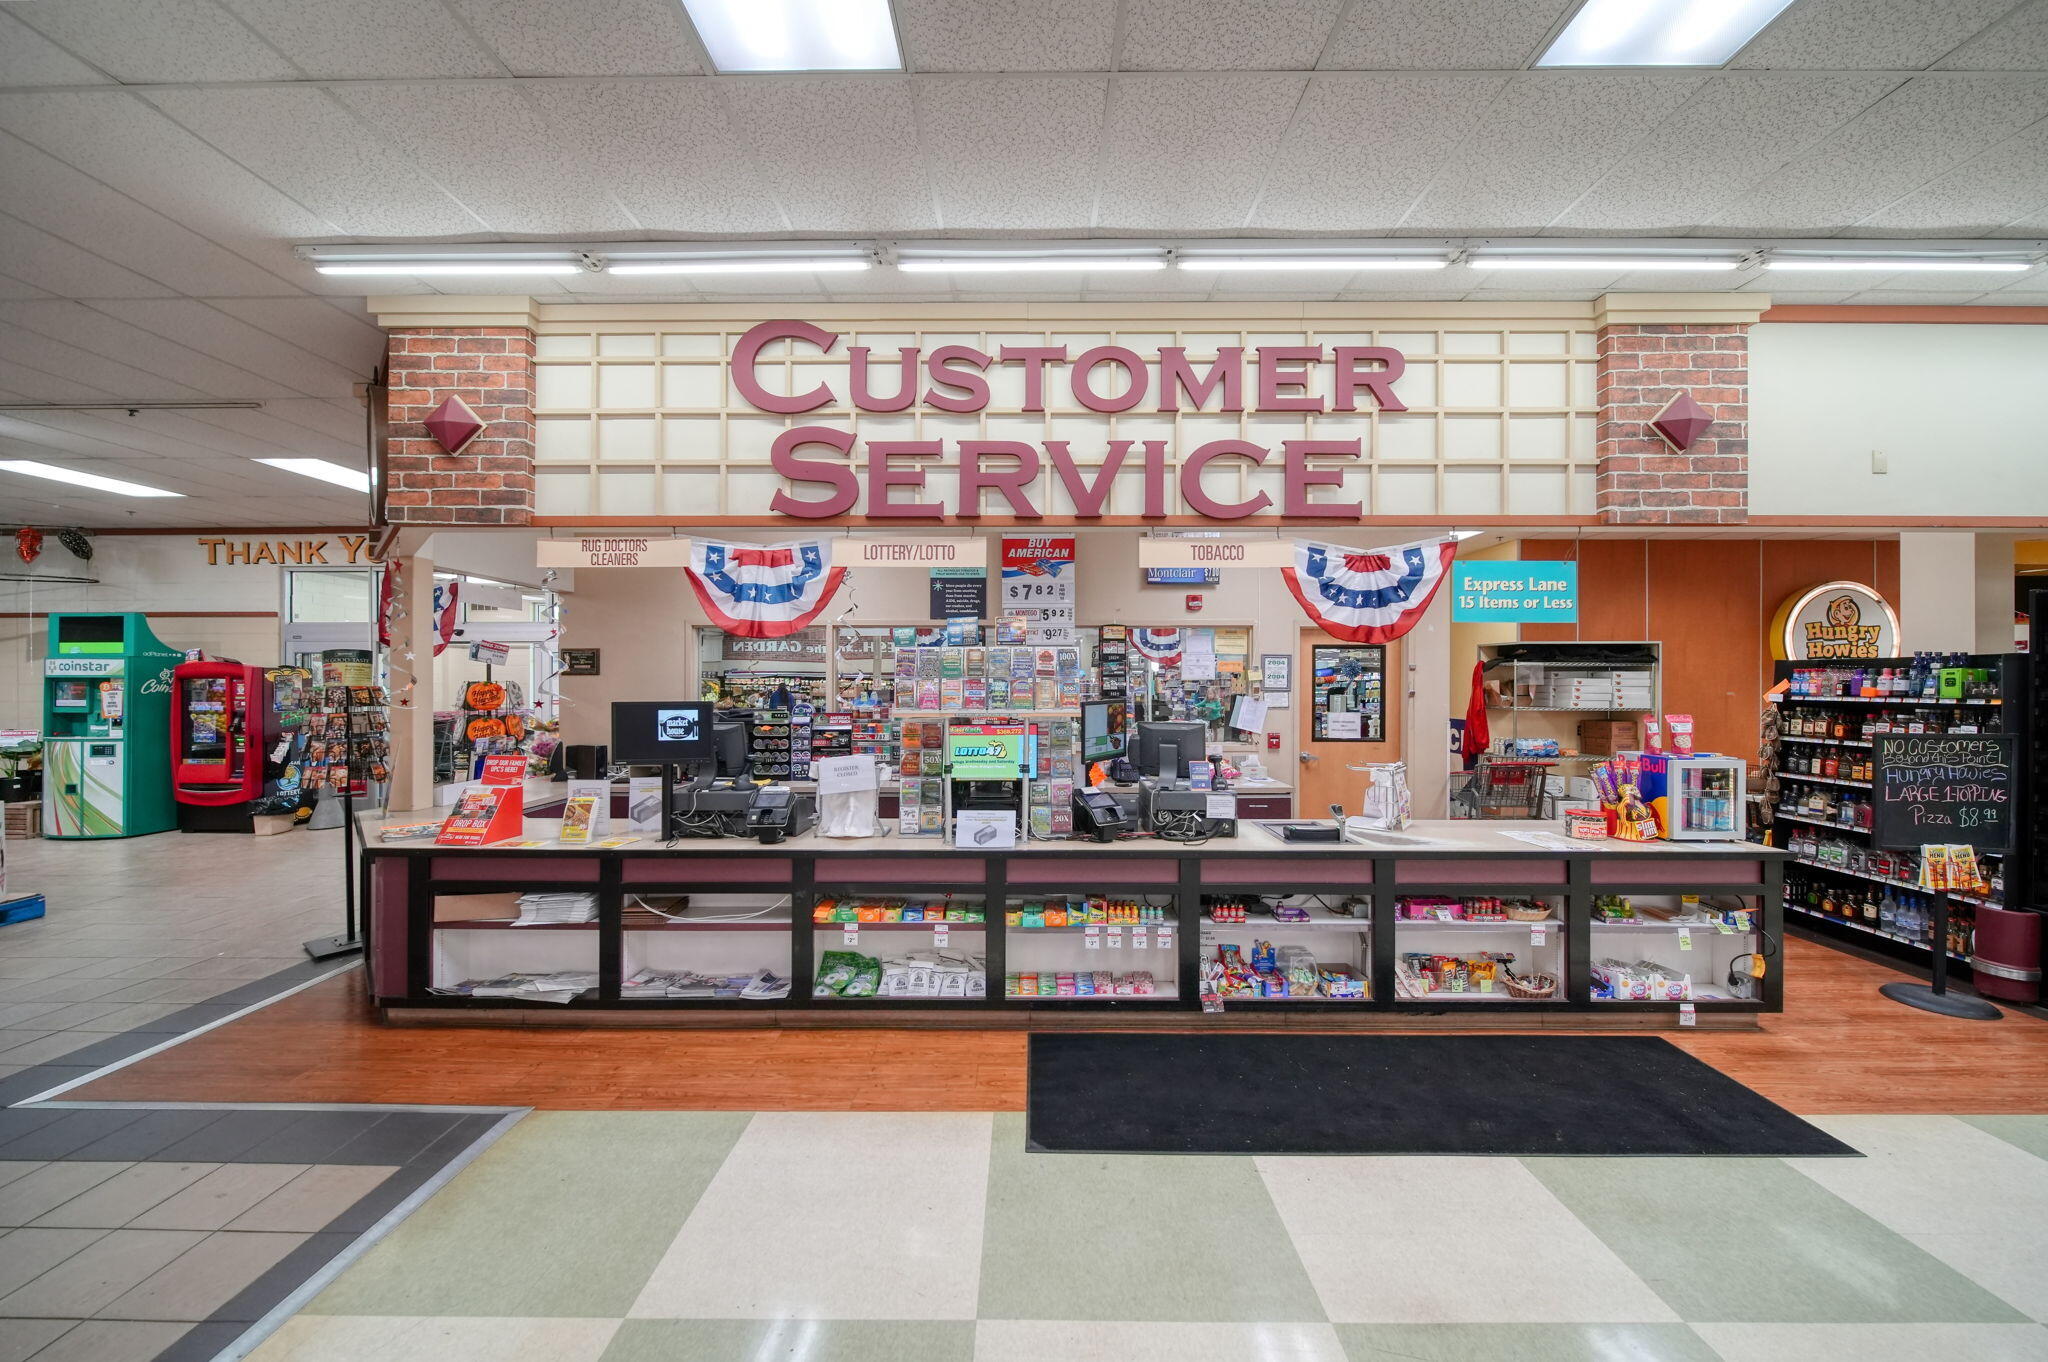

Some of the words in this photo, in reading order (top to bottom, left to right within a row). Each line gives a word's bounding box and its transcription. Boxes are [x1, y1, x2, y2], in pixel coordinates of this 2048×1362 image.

[730, 319, 1408, 414] CUSTOMER
[769, 425, 1363, 520] SERVICE
[198, 537, 328, 565] THANK
[581, 538, 601, 552] RUG
[604, 538, 648, 552] DOCTORS
[1028, 538, 1053, 548] BUY
[590, 552, 638, 566] CLEANERS
[863, 544, 955, 560] LOTTERY/LOTTO
[1007, 548, 1069, 558] AMERICAN
[1190, 544, 1245, 560] TOBACCO
[1148, 568, 1197, 578] Montclair
[1464, 576, 1524, 595] Express
[1528, 576, 1568, 592] Lane
[1458, 596, 1475, 609] 15
[1479, 596, 1519, 609] Items
[1523, 598, 1540, 609] or
[1543, 596, 1573, 609] Less
[1804, 621, 1881, 644] Hungry
[1806, 641, 1879, 659] Howie's
[58, 661, 110, 672] coinstar
[472, 690, 493, 698] Happy
[666, 718, 688, 726] market
[666, 726, 684, 734] house
[1883, 739, 1904, 755] NO
[1641, 757, 1666, 774] Bull
[1884, 785, 1940, 802] LARGE
[1908, 804, 1952, 826] Pizza
